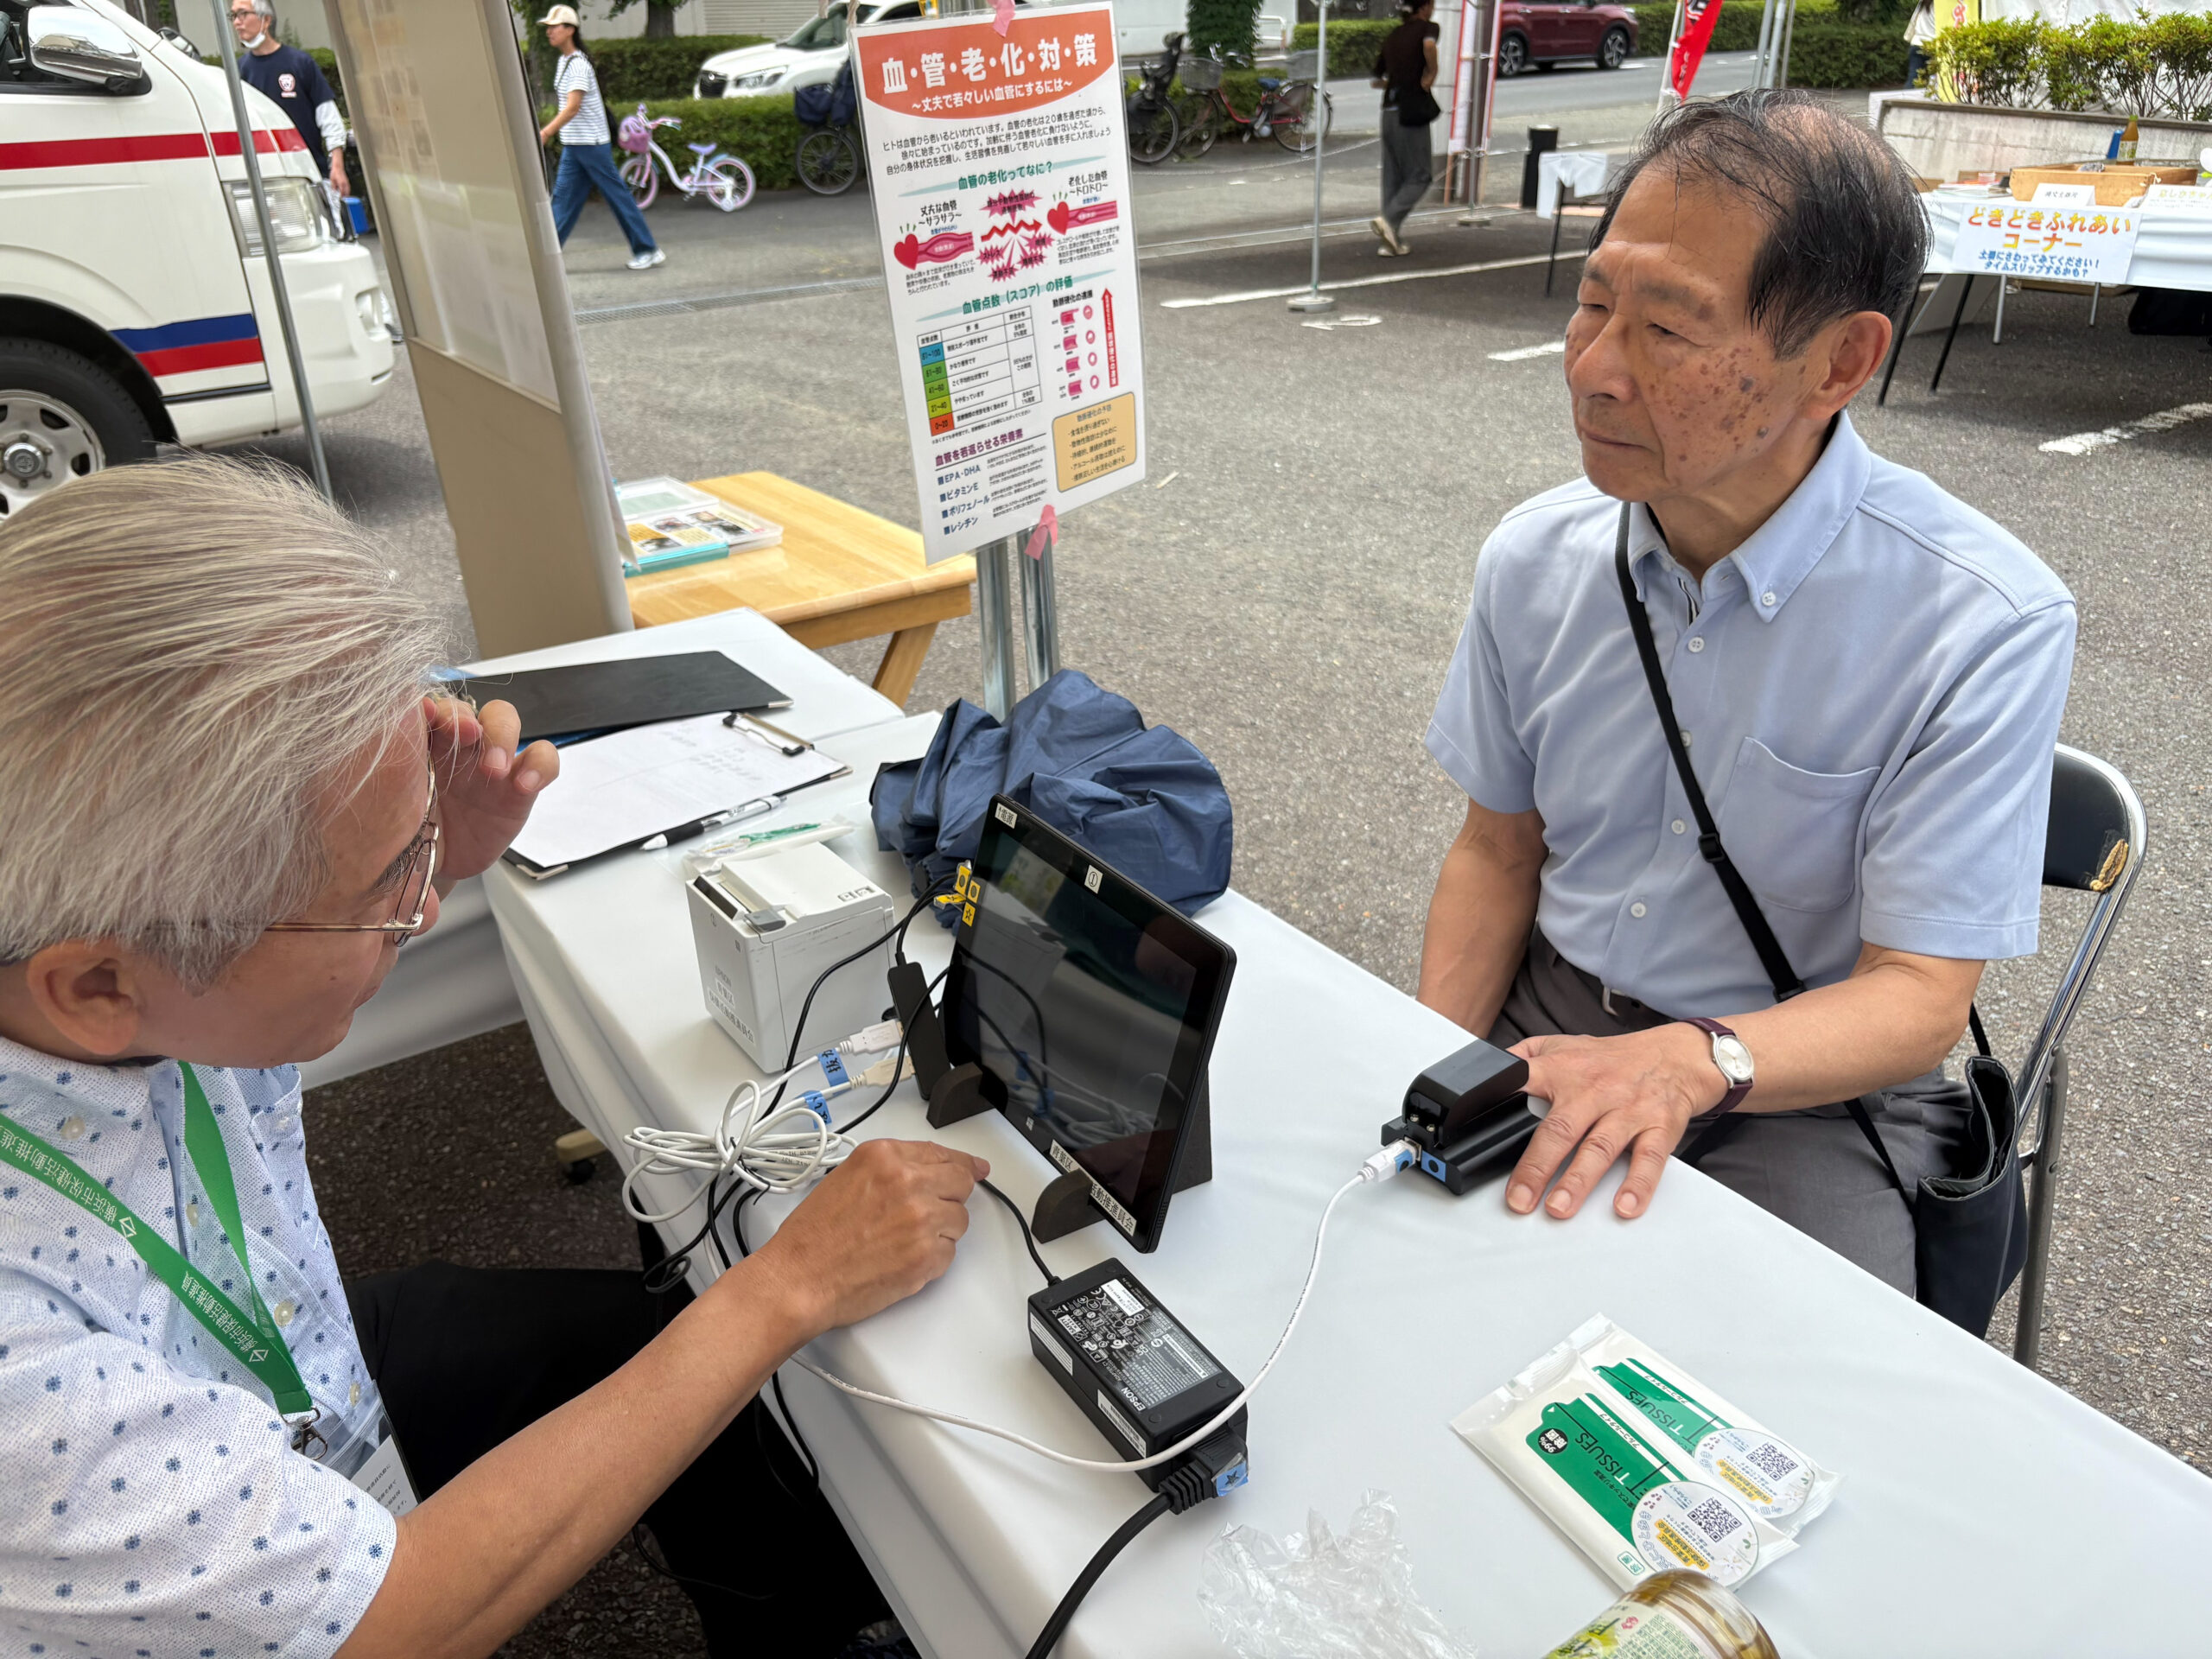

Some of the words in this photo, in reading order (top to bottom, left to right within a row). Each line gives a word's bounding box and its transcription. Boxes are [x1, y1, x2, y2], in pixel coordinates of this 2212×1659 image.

[882, 34, 1097, 94] 血・管・老・化・対・策
[1967, 206, 2132, 235] どきどきふれあい
[2003, 233, 2083, 252] コーナー
[1122, 1387, 1146, 1412] EPSON
[1644, 1375, 1688, 1405] アルコールタイプ
[1625, 1390, 1684, 1435] TISSUES
[1539, 1436, 1556, 1453] 99%
[1545, 1428, 1567, 1449] 除菌
[1599, 1414, 1642, 1449] アルコールタイプ
[1575, 1432, 1630, 1485] TISSUES
[1593, 1470, 1637, 1511] 果でスッキリ清潔
